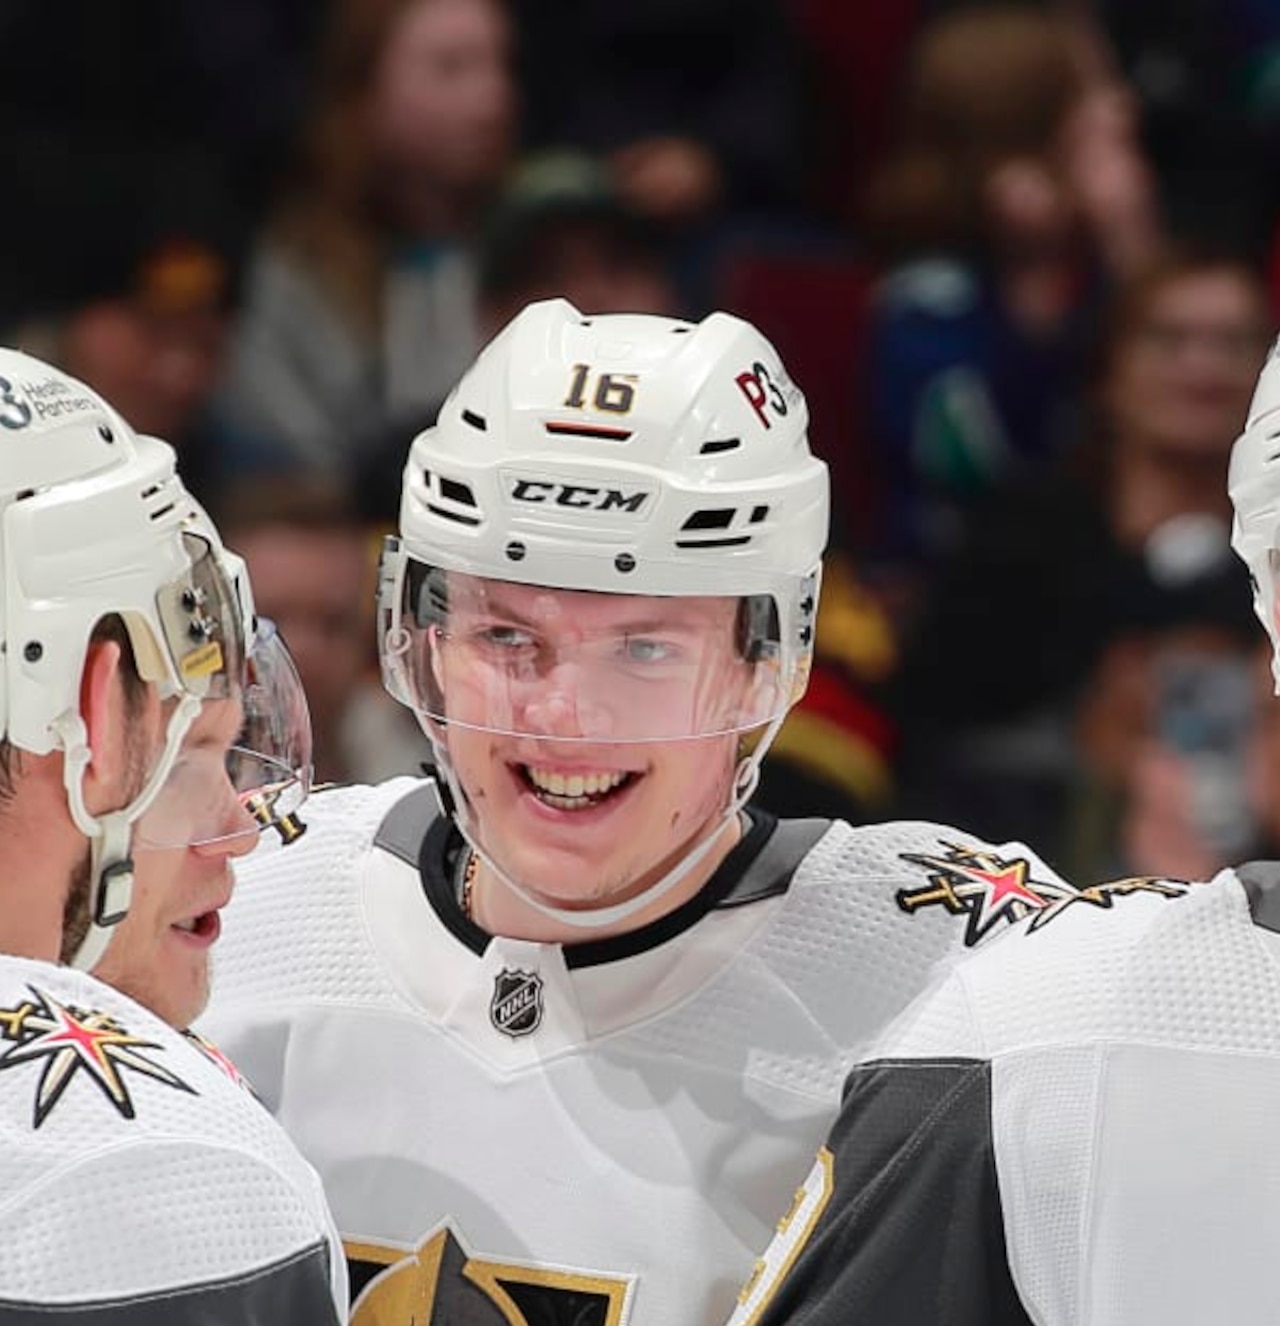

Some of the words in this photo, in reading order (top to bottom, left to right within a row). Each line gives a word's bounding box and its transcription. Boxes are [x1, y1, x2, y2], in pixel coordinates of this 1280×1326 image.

[565, 362, 641, 416] 16
[734, 361, 788, 431] P3
[513, 480, 649, 512] CCM
